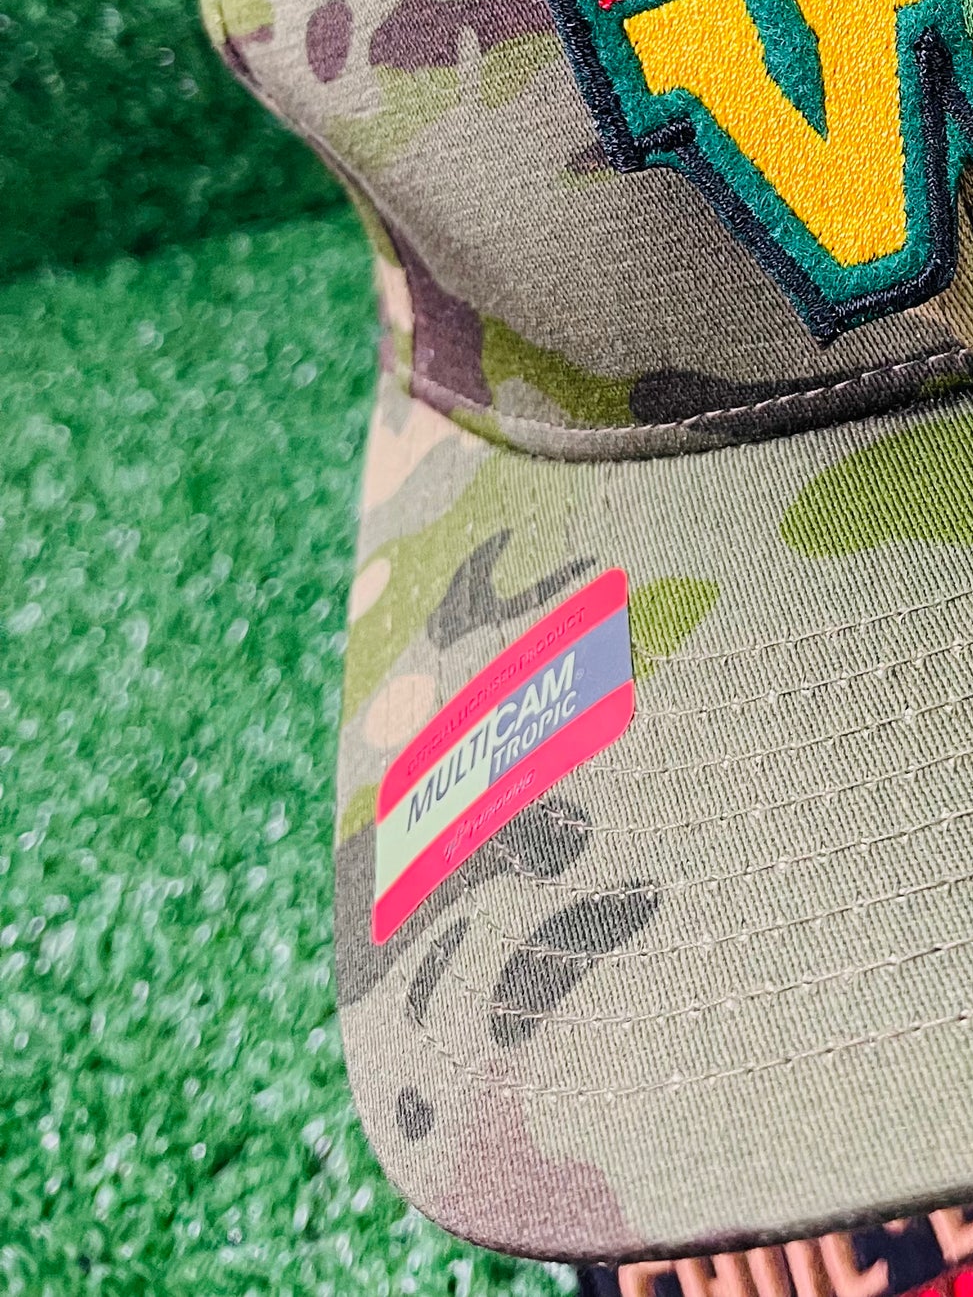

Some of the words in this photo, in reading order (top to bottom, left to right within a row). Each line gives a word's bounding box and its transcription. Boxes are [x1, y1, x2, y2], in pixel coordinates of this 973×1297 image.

[519, 606, 586, 671] PRODUCT
[406, 650, 576, 833] MULTICAM
[493, 690, 577, 774] TROPIC
